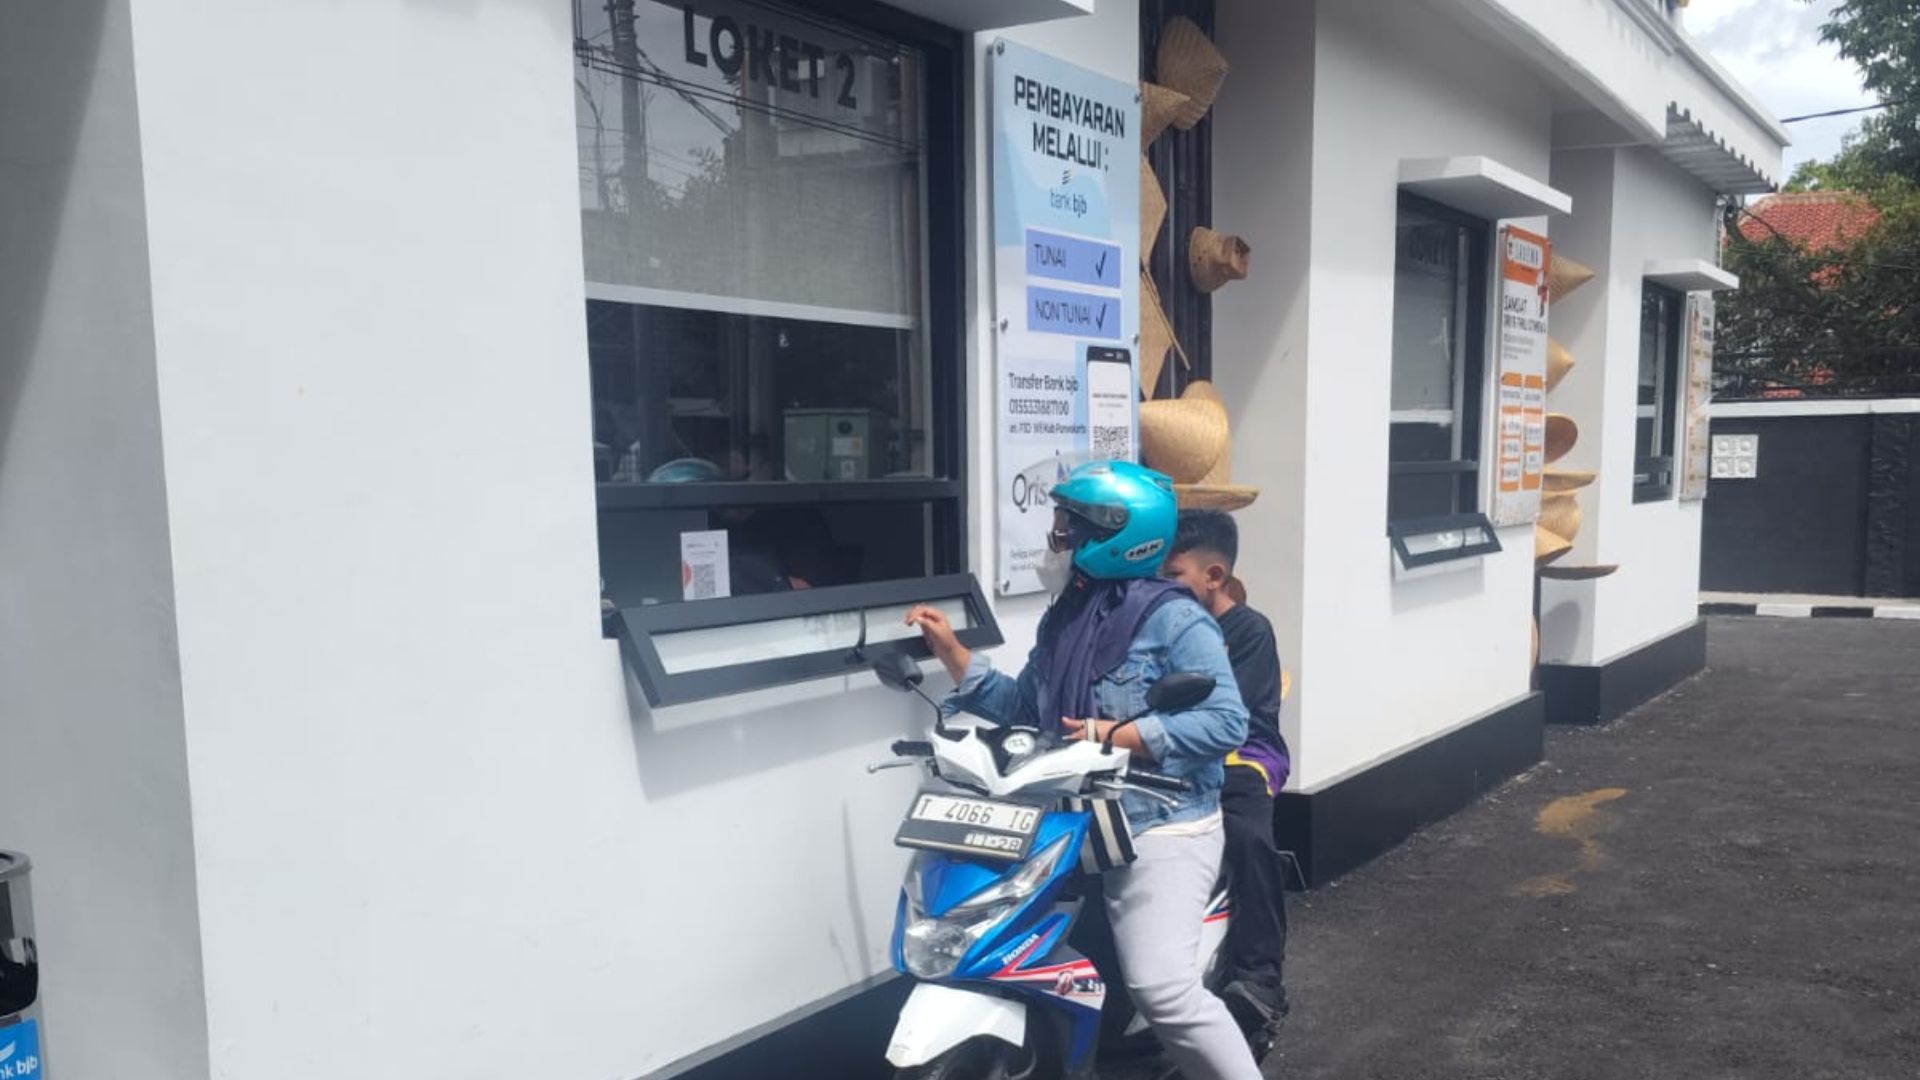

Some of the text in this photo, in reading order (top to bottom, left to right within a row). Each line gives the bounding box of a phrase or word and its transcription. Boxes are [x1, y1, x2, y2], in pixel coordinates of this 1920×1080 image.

[684, 3, 857, 109] LOKET 2
[1014, 75, 1126, 139] PEMBAYARAN
[1050, 189, 1087, 218] bank bjb
[1033, 244, 1066, 268] TUNAI
[1035, 300, 1090, 326] NON TUNAI
[1008, 372, 1079, 396] Transfer Bank bjb
[919, 798, 1034, 831] T 4066 IG
[1002, 933, 1040, 966] HONDA
[16, 1055, 38, 1076] bjb
